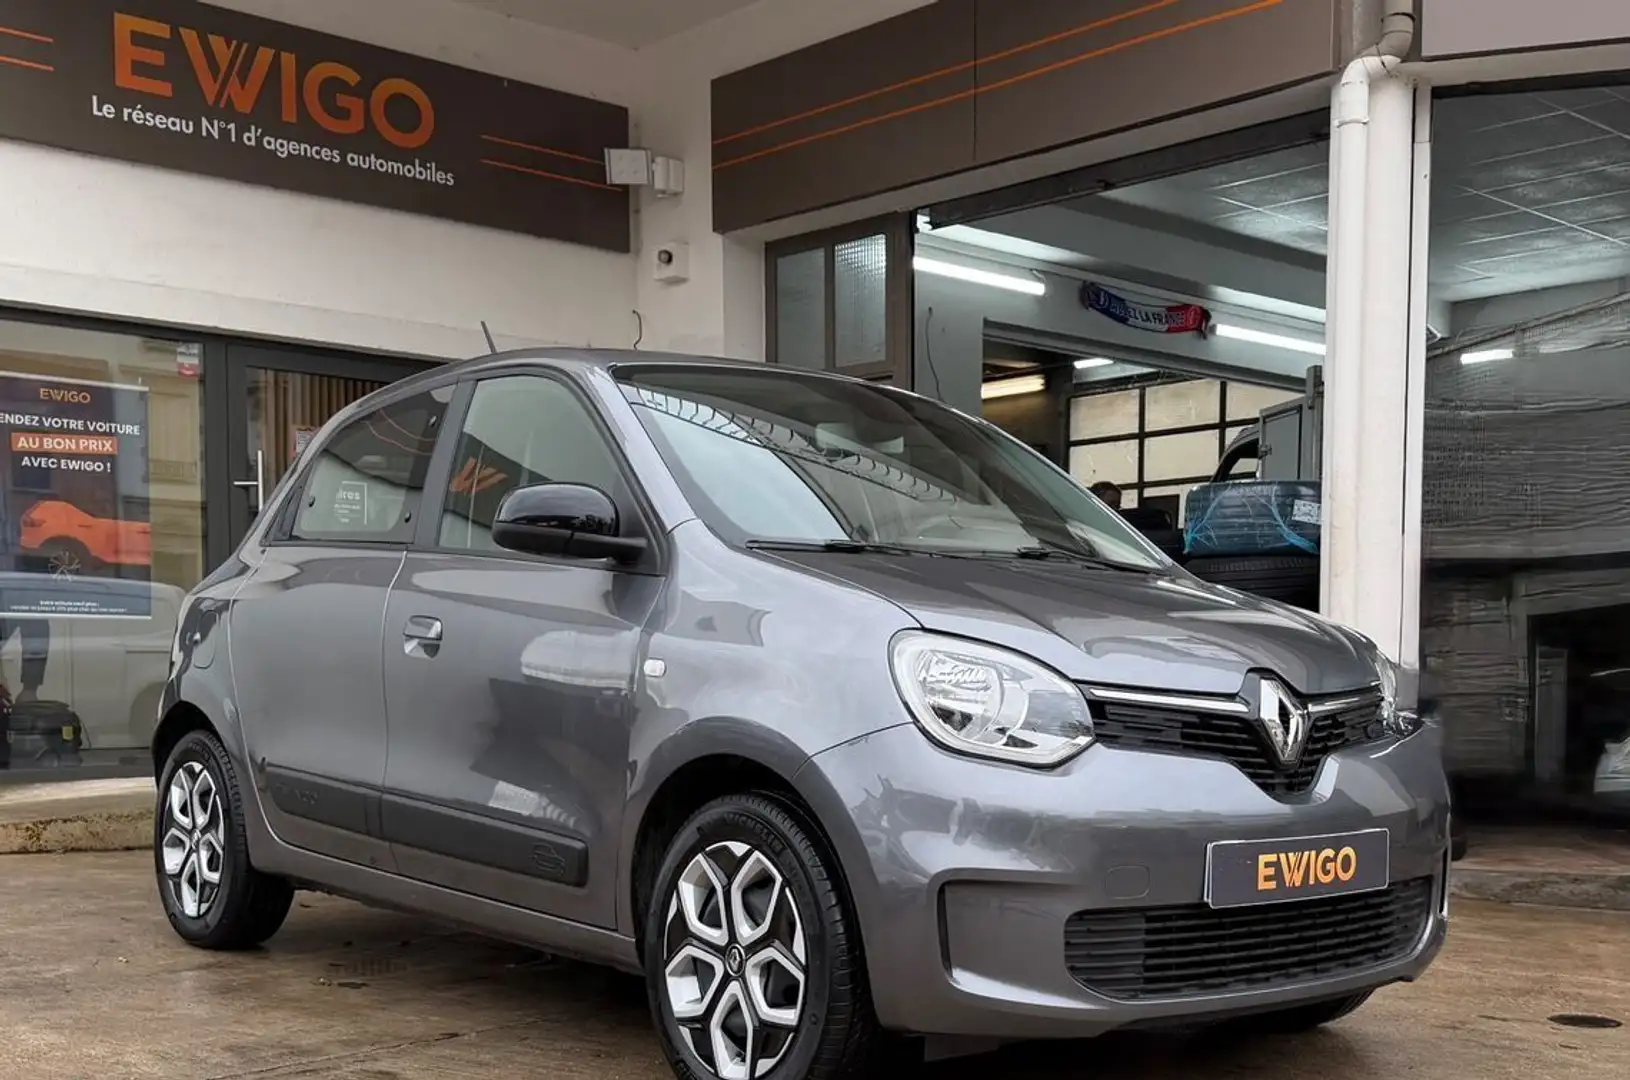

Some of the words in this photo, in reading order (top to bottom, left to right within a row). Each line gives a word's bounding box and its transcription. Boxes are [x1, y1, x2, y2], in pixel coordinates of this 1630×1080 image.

[113, 11, 435, 148] EWIGO
[91, 94, 116, 119] Le
[122, 104, 194, 134] réseau
[201, 116, 236, 143] N°1
[242, 125, 341, 164] d'agences
[346, 152, 455, 186] automobiles
[39, 387, 91, 404] EWIGO
[42, 416, 84, 431] VOTRE
[87, 421, 140, 436] VOITURE
[17, 436, 39, 449] AU
[43, 437, 76, 450] BON
[79, 438, 113, 452] PRIX
[21, 456, 58, 469] AVEC
[60, 459, 104, 472] EWIGO
[1256, 845, 1357, 891] EWIGO
